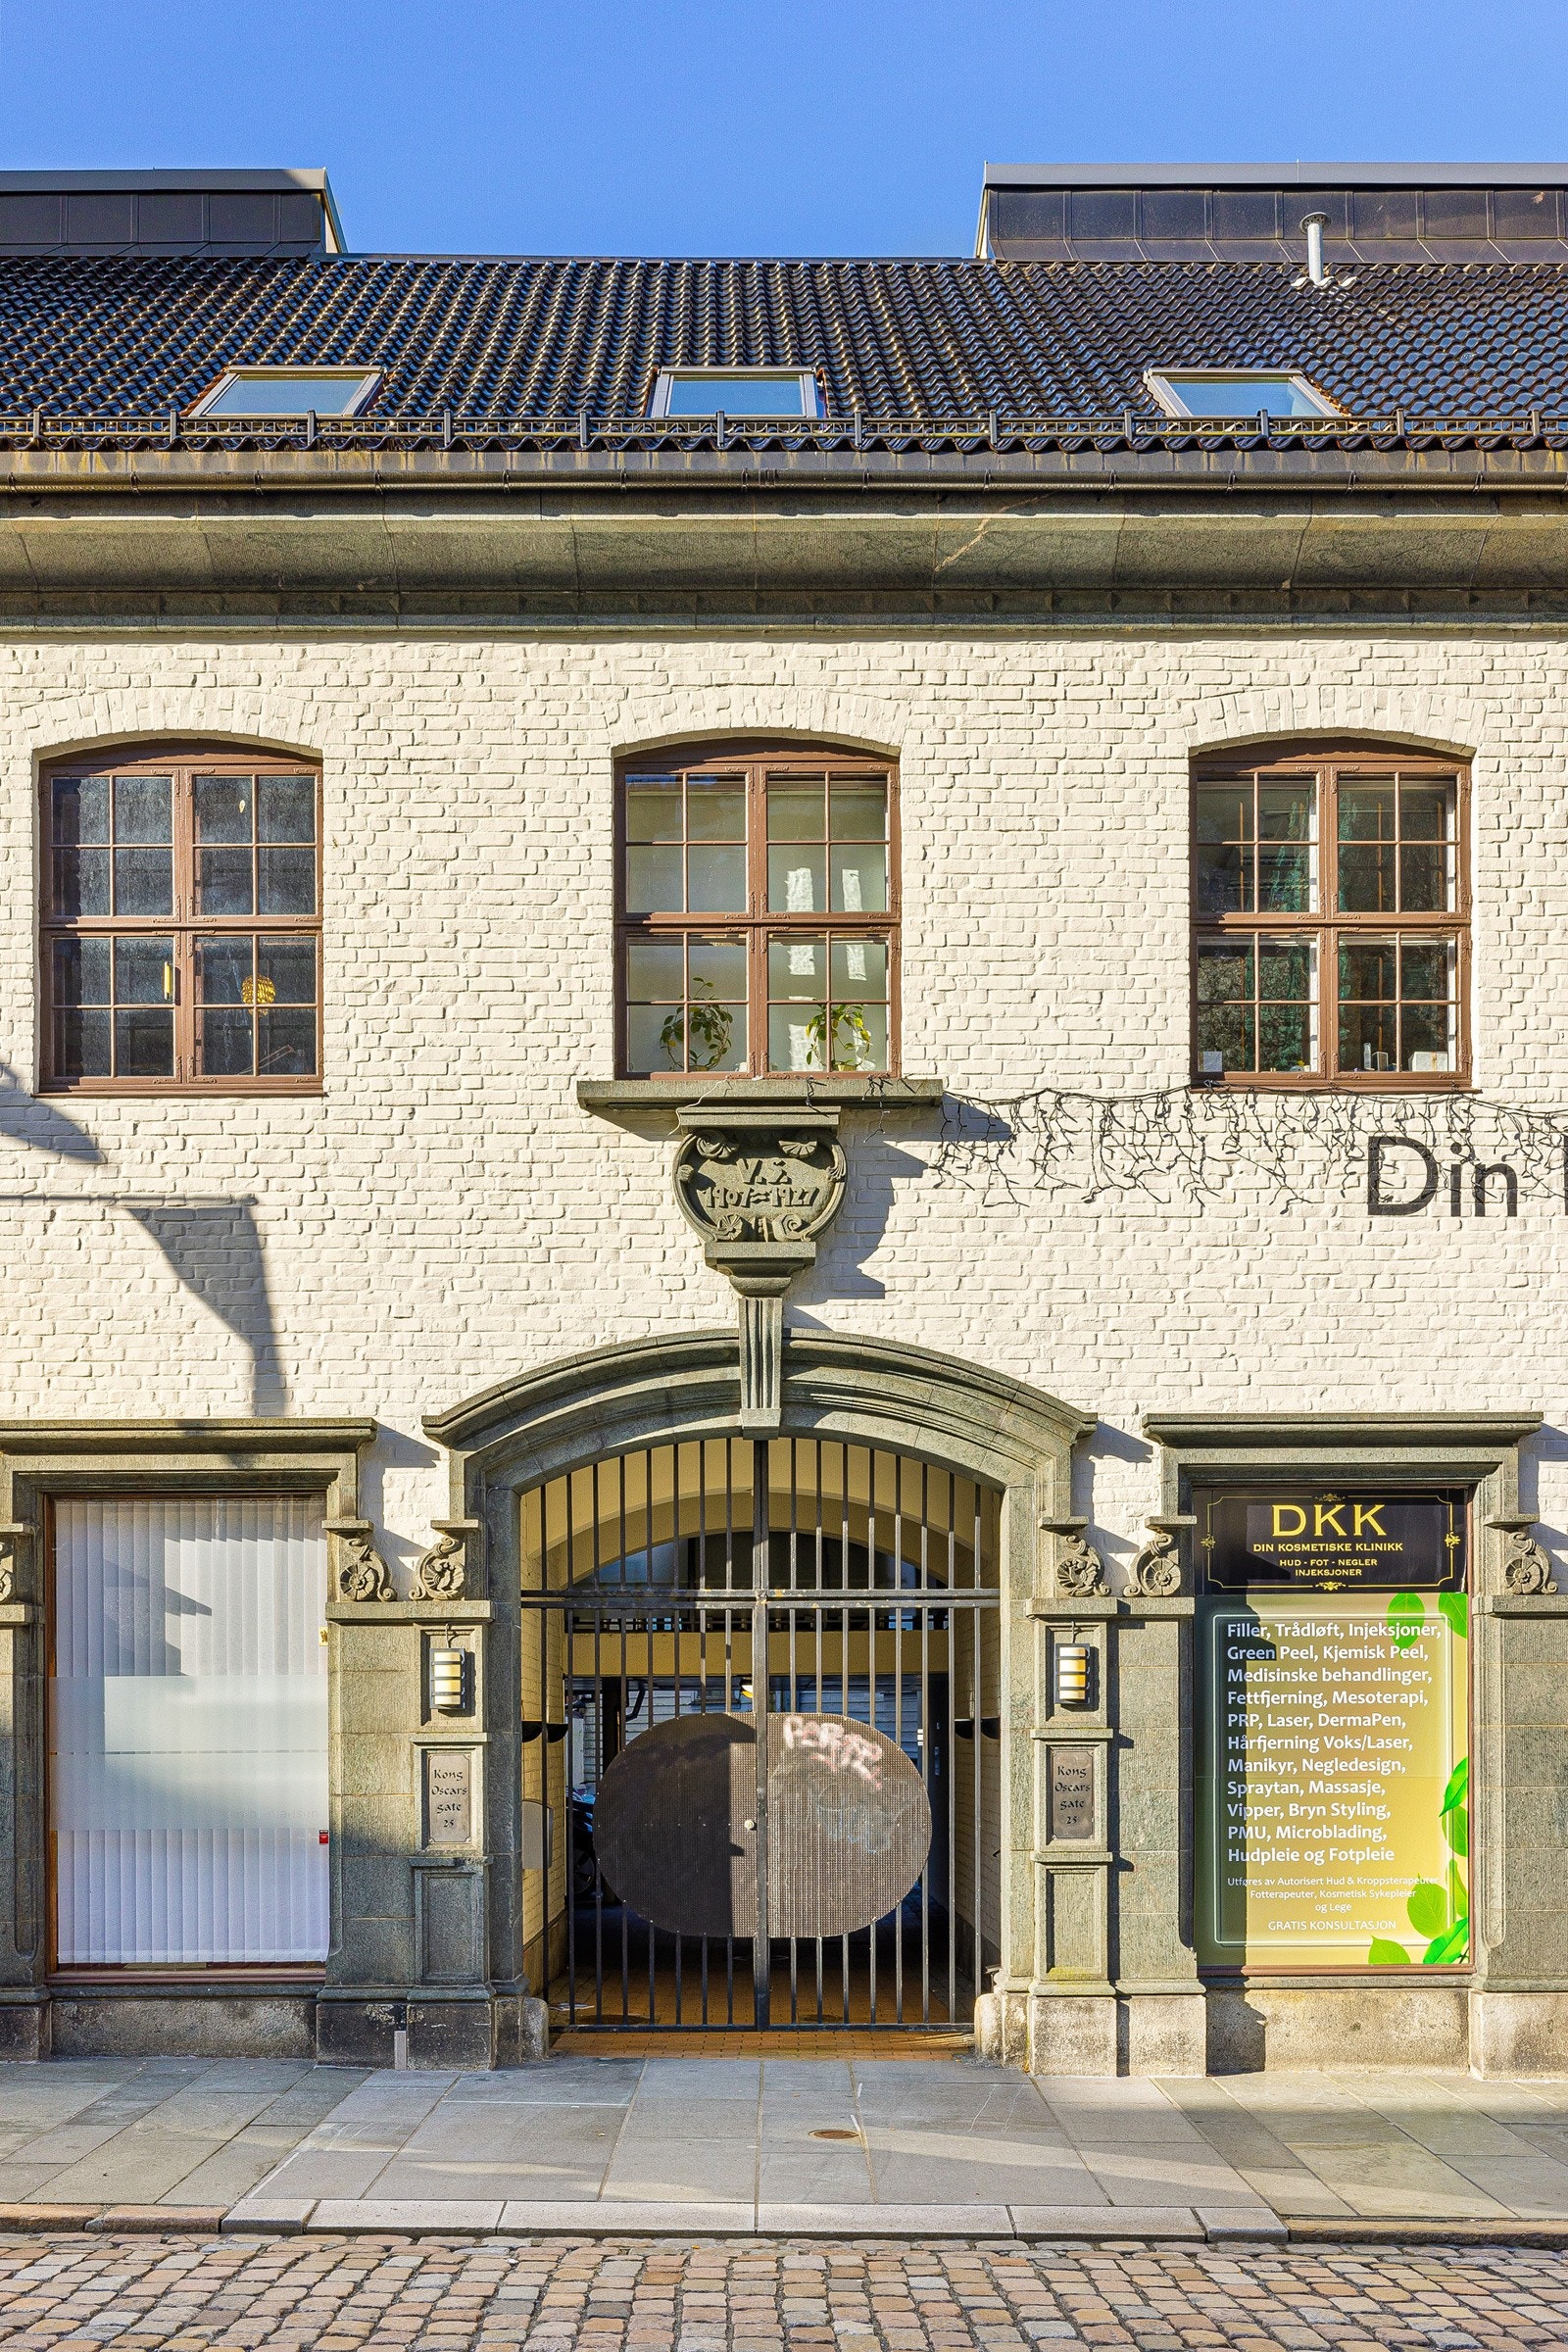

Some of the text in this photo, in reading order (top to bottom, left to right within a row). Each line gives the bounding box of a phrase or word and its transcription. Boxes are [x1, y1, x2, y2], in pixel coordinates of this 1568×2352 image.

[1367, 1136, 1518, 1217] Din
[1272, 1504, 1387, 1537] DKK
[1253, 1543, 1403, 1552] DIN KOSMETISKE KLINIKK
[1227, 1623, 1442, 1641] Filler, Trådløft, Injeksjoner,
[1227, 1646, 1429, 1663] Green Peel, Kjemisk Peel,
[1228, 1668, 1433, 1686] Medisinske behandlinger,
[1228, 1690, 1429, 1707] Fettfjerning, Mesoterapi,
[1228, 1713, 1406, 1729] PRP, Laser, DermaPen,
[1228, 1735, 1413, 1752] Hårfjerning Voks/Laser,
[1057, 1766, 1087, 1778] Kong
[1228, 1758, 1406, 1776] Manikyr, Negledesign,
[434, 1770, 464, 1781] Kong
[431, 1786, 466, 1794] Oscars
[1054, 1783, 1091, 1791] Oscars
[1227, 1780, 1386, 1797] Spraytan, Massasje,
[436, 1803, 462, 1813] gate
[1060, 1799, 1084, 1810] gate
[1227, 1803, 1392, 1820] Vipper, Bryn Styling,
[1228, 1825, 1388, 1842] PMU, Microblading,
[1228, 1846, 1395, 1866] Hudpleie og Fotpleie
[1278, 1877, 1324, 1886] Autorisert
[1250, 1889, 1317, 1899] Fotterapeuter,
[1319, 1889, 1366, 1898] Kosmetisk
[1315, 1903, 1352, 1913] og Lege
[1268, 1921, 1396, 1931] GRATIS KONSULTASJON
